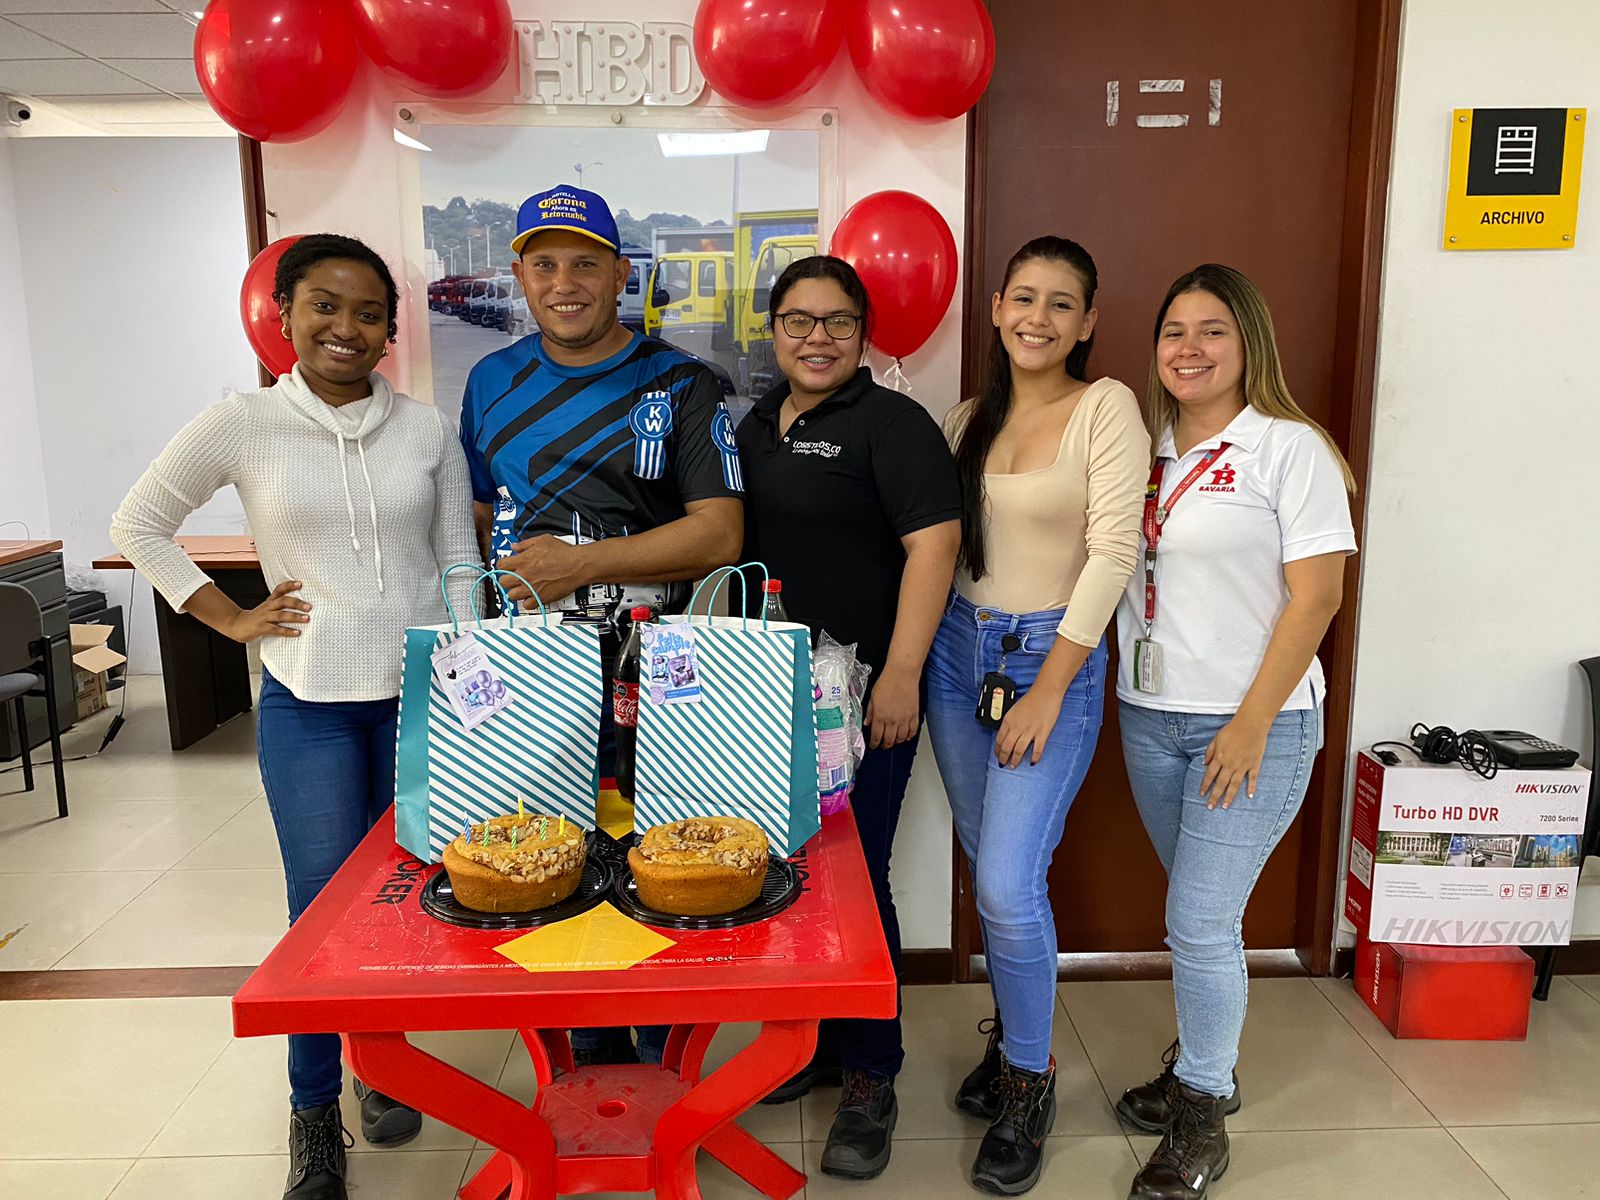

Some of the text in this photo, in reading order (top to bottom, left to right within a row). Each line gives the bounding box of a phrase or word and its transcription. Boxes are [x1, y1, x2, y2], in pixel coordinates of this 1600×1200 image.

[512, 20, 706, 106] HBD
[538, 197, 587, 209] Corona
[541, 211, 587, 222] Retornable
[1480, 211, 1545, 225] ARCHIVO
[831, 686, 841, 695] 25
[1515, 783, 1581, 794] HIKVISION
[1393, 805, 1499, 822] Turbo HD DVR
[1539, 814, 1556, 822] 7200
[371, 859, 427, 905] OKER
[1380, 917, 1570, 944] HIKVISION
